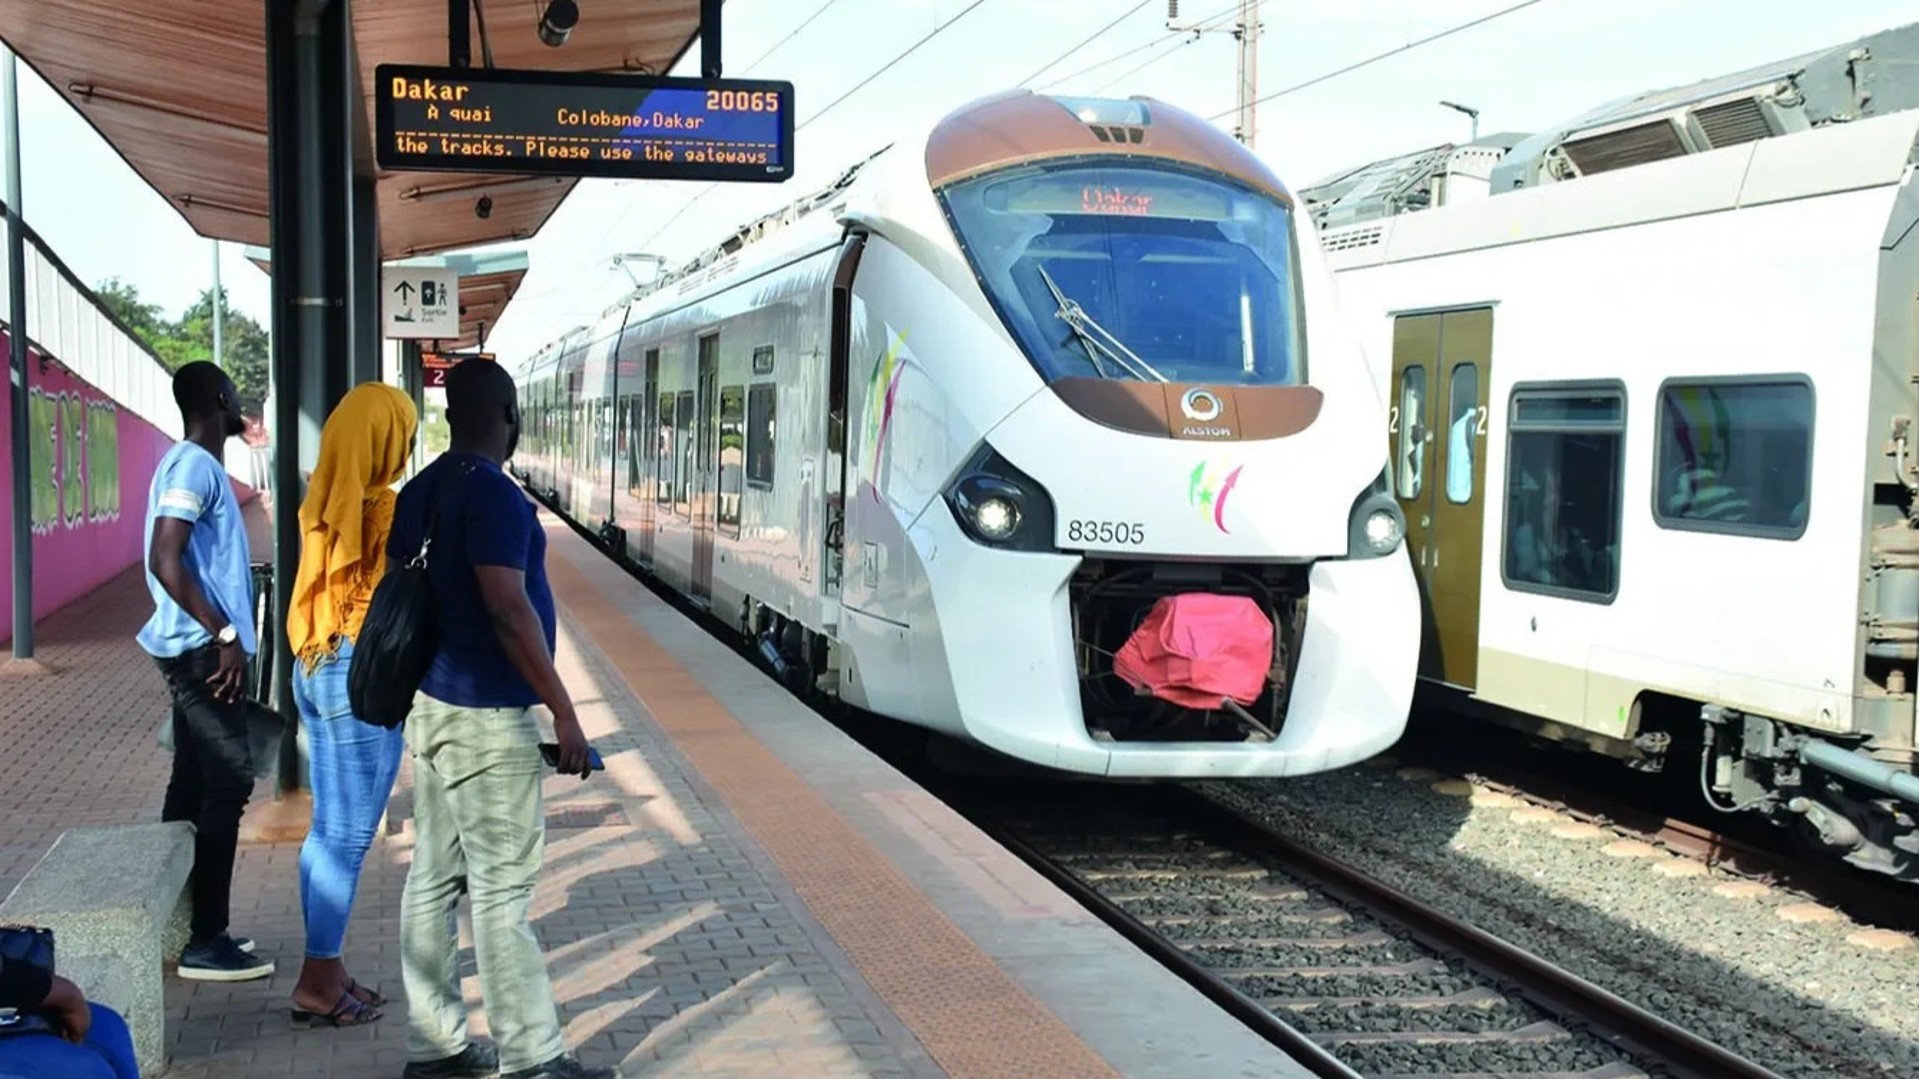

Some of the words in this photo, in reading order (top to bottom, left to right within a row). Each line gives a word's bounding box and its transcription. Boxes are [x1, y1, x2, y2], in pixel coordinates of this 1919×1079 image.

[392, 77, 469, 101] Dakar
[706, 90, 779, 112] 20065
[449, 105, 492, 122] quai
[397, 137, 428, 154] the
[441, 139, 513, 157] tracks.
[526, 141, 590, 158] Please
[601, 147, 632, 160] use
[645, 146, 674, 162] the
[684, 148, 768, 165] gateways
[433, 369, 444, 385] 2
[1389, 406, 1399, 433] 2
[1476, 405, 1487, 435] 2
[1068, 520, 1145, 544] 83505
